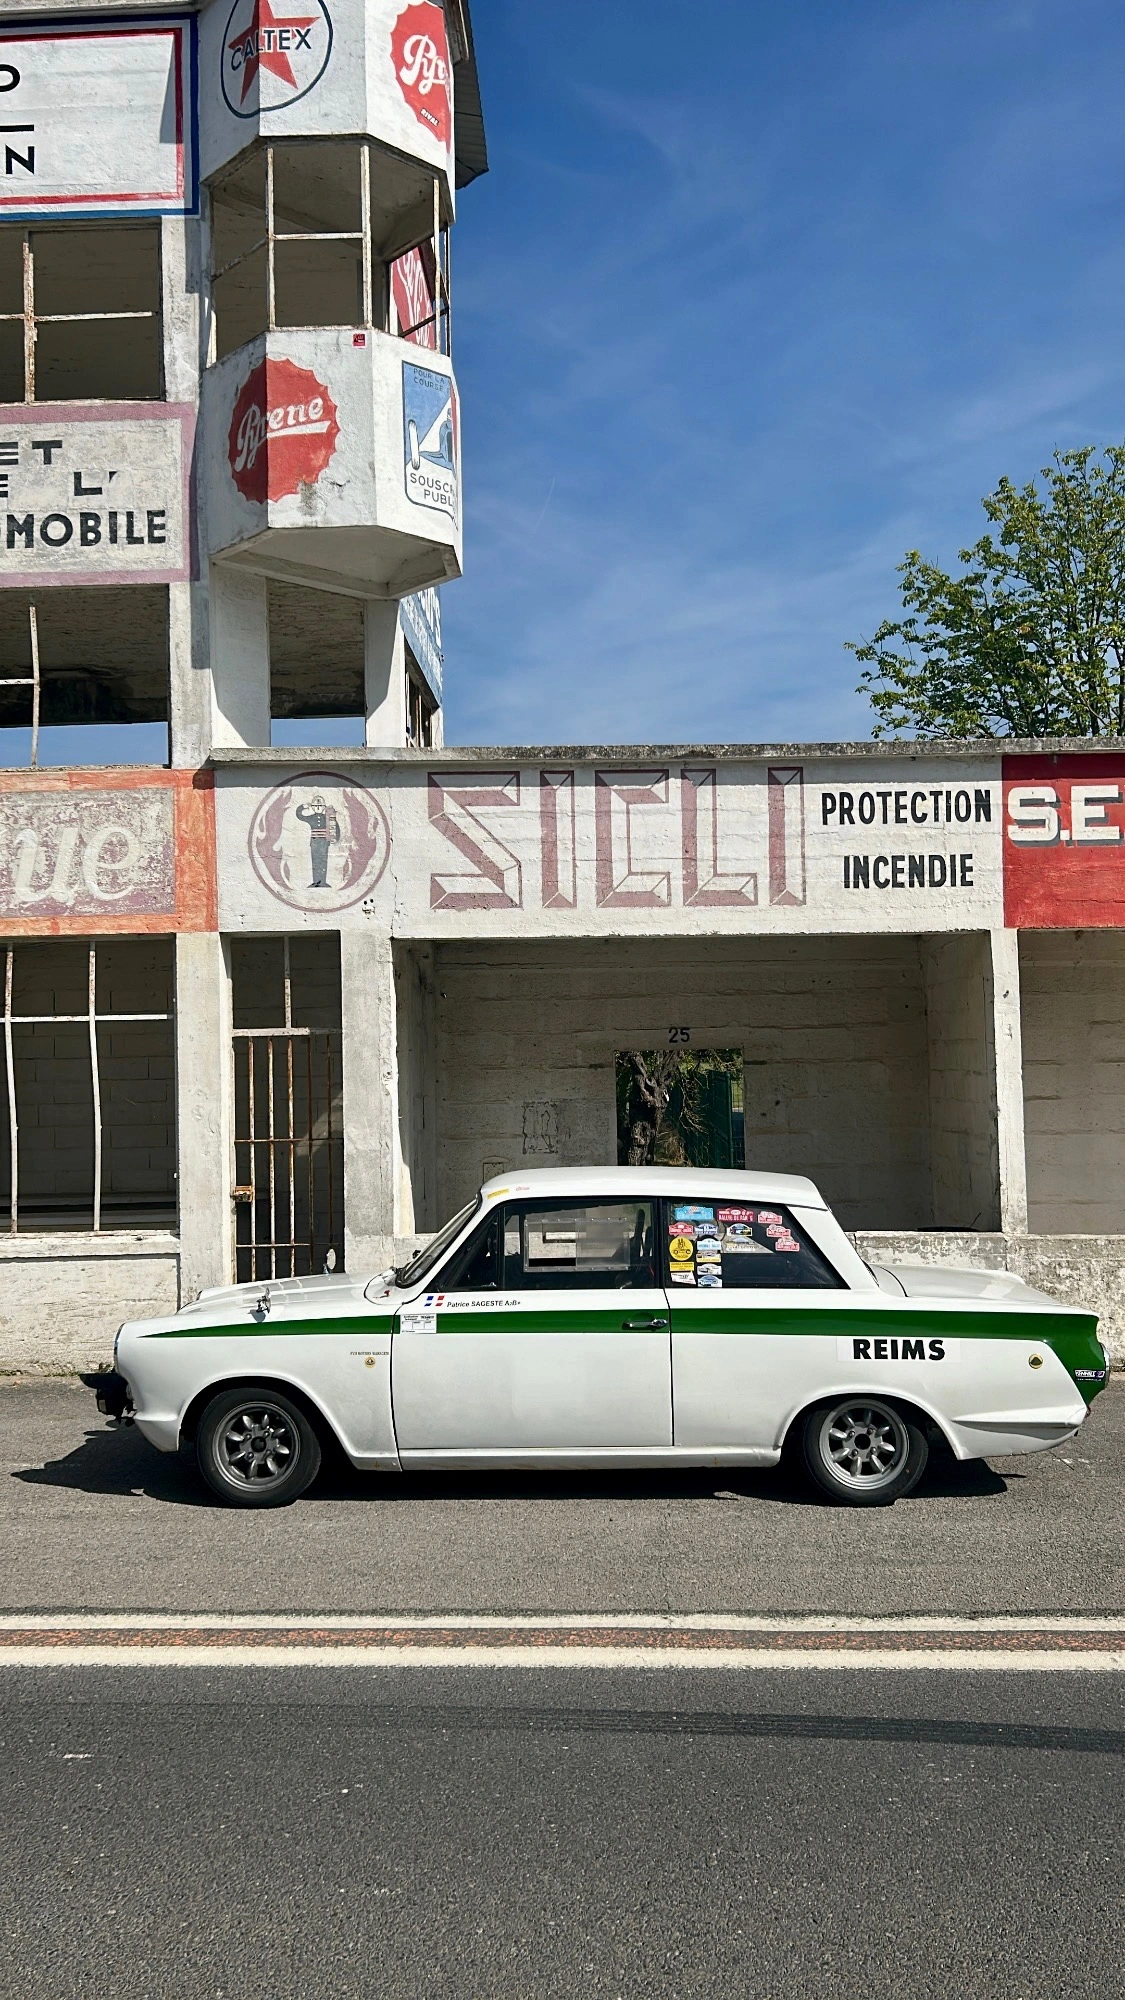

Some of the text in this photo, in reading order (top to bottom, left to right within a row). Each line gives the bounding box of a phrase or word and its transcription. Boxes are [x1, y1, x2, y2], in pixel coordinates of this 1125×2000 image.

[231, 28, 312, 71] CALTEX
[420, 108, 439, 126] RIVAL
[413, 368, 445, 384] POUR LA
[413, 376, 443, 392] COURSE
[234, 397, 323, 472] Pyrene
[7, 510, 166, 549] MOBILE
[822, 788, 992, 825] PROTECTION
[428, 767, 806, 910] SICLI
[843, 853, 974, 889] INCENDIE
[668, 1027, 690, 1043] 25
[853, 1339, 945, 1360] REIMS
